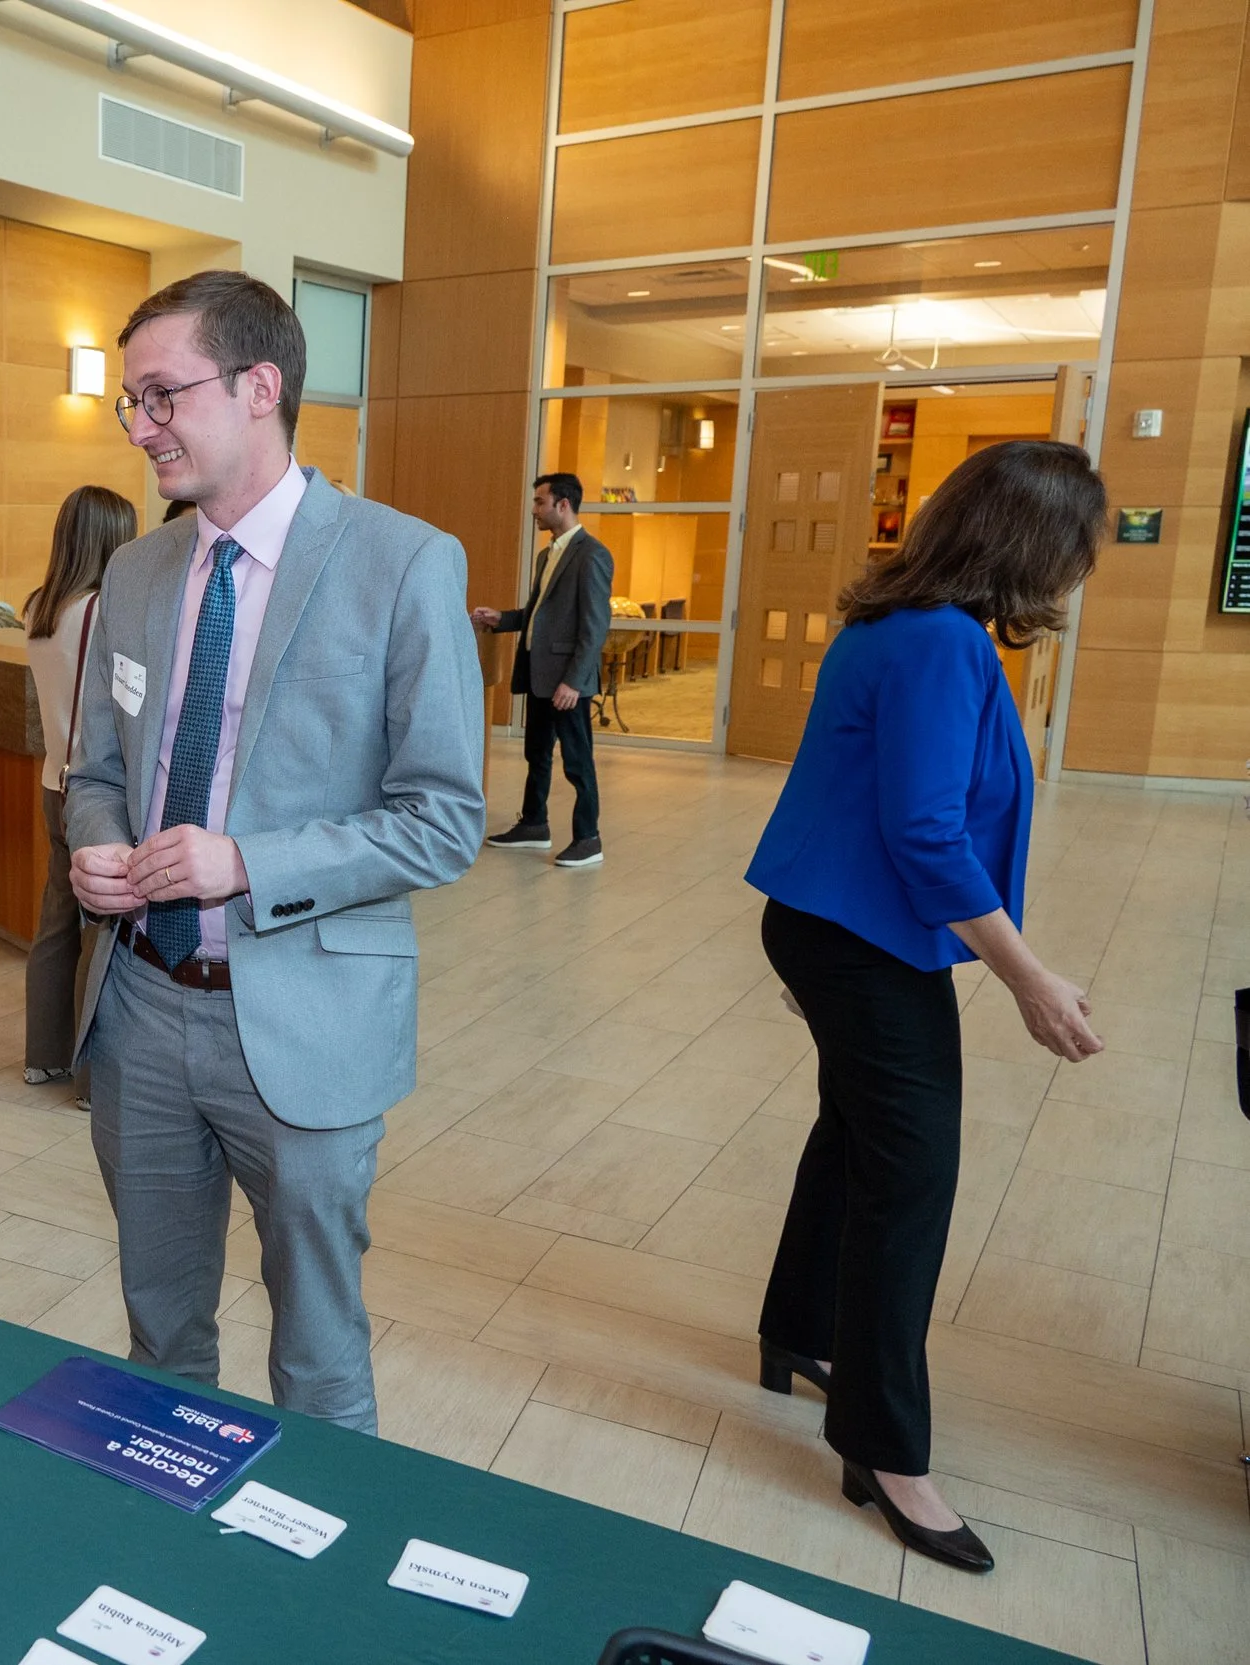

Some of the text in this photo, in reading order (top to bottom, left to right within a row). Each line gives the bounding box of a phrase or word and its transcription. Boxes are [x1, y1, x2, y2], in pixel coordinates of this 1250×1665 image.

[172, 1408, 219, 1432] babc
[178, 1404, 223, 1424] CENTRAL FLORIDA
[106, 1440, 206, 1488] Become a
[130, 1434, 219, 1477] member.
[241, 1496, 328, 1539] Wesser-Brawner
[258, 1513, 298, 1534] Andrea
[408, 1561, 466, 1586] Krymski
[469, 1581, 510, 1600] Karen
[98, 1602, 134, 1625] Rubin
[135, 1621, 186, 1648] Anjelica
